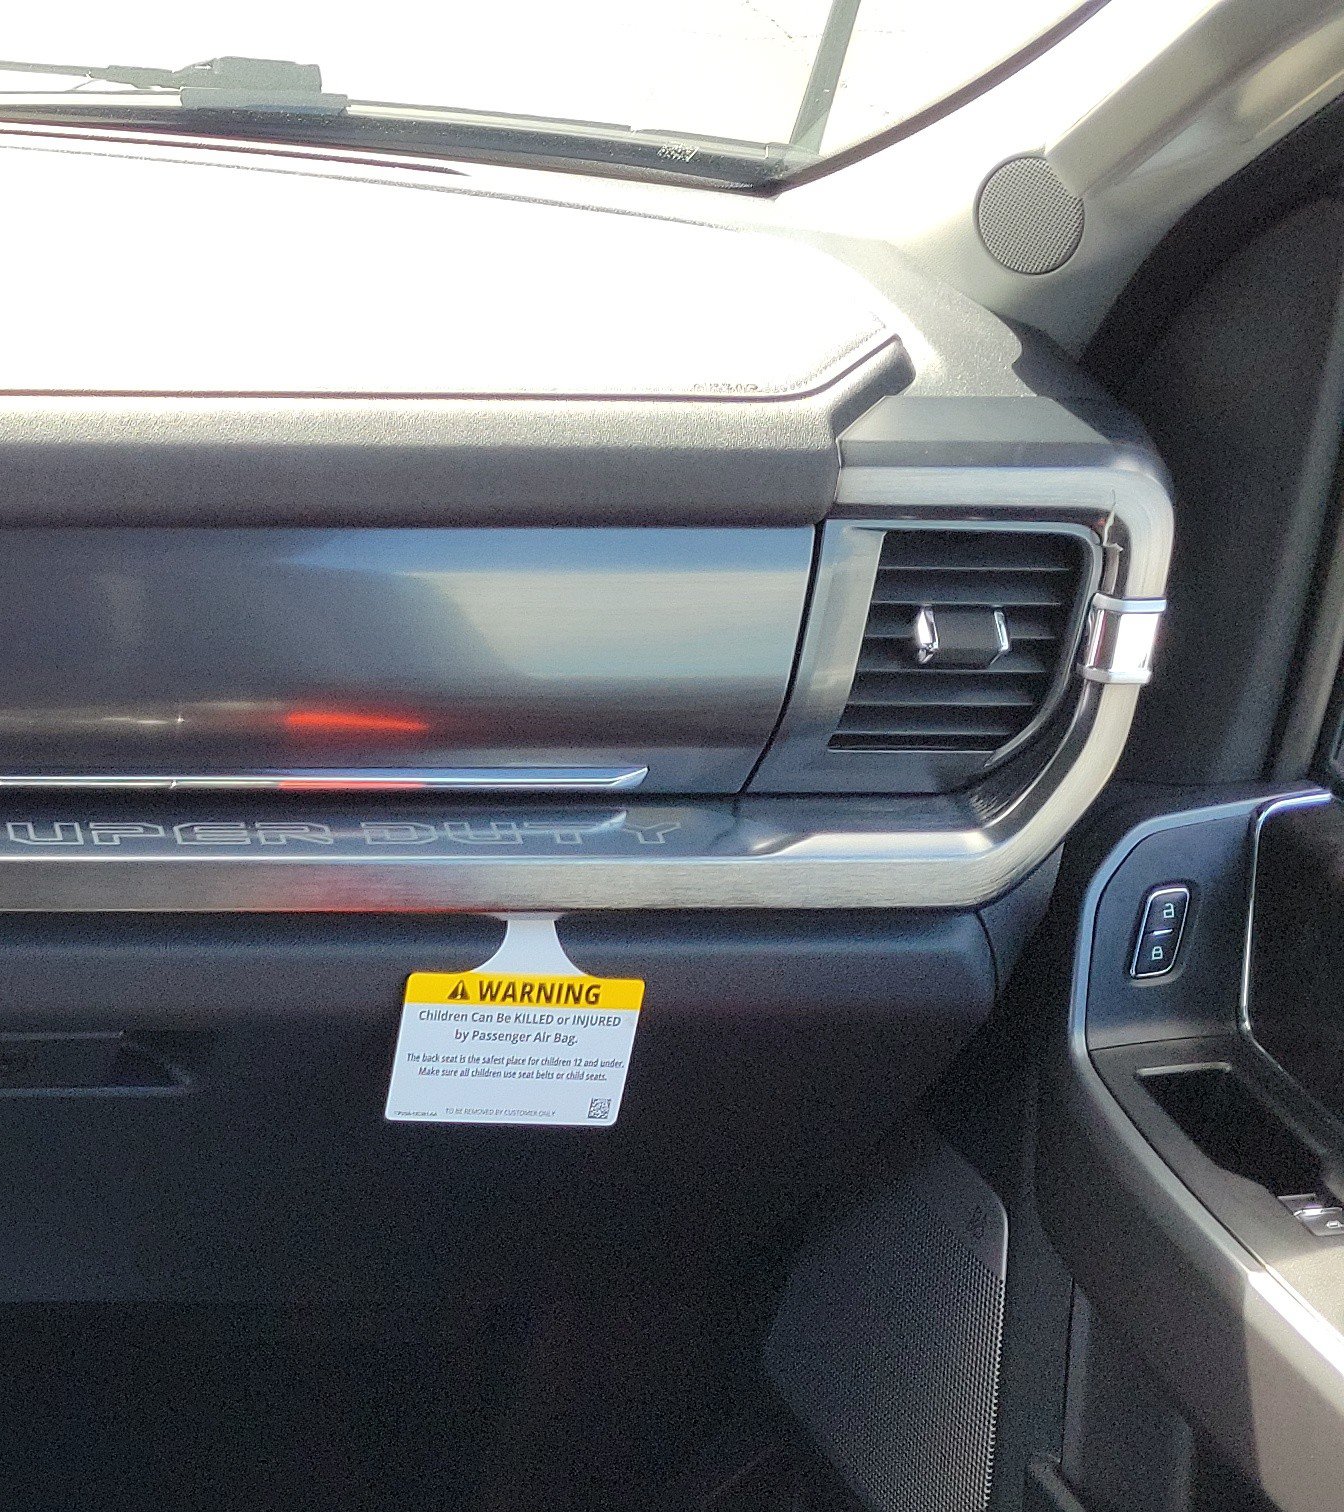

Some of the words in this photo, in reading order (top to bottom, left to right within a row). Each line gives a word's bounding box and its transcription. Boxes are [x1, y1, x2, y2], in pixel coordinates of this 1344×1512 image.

[361, 818, 682, 847] DUTY
[478, 979, 602, 1006] WARNING
[419, 1010, 468, 1023] Children
[471, 1012, 493, 1023] Can
[496, 1013, 511, 1024] Be
[514, 1013, 554, 1025] KILLED
[557, 1016, 570, 1026] or
[572, 1015, 622, 1027] INJURED
[454, 1029, 469, 1043] by
[471, 1029, 531, 1045] Passenger
[533, 1031, 551, 1043] Air
[554, 1031, 579, 1046] Bag.
[407, 1053, 420, 1062] The
[422, 1053, 440, 1063] back
[441, 1054, 458, 1063] seat
[459, 1054, 466, 1063] is
[468, 1054, 480, 1064] the
[482, 1054, 505, 1065] safest
[506, 1056, 526, 1067] place
[528, 1056, 539, 1066] for
[541, 1057, 571, 1067] children
[573, 1058, 582, 1067] 12
[584, 1058, 598, 1068] and
[600, 1058, 624, 1068] under.
[418, 1066, 440, 1076] Make
[441, 1068, 459, 1077] sure
[460, 1068, 470, 1077] all
[471, 1068, 502, 1078] children
[504, 1070, 516, 1079] use
[518, 1070, 535, 1079] seat
[536, 1070, 555, 1080] belts
[556, 1072, 564, 1080] or
[566, 1071, 584, 1080] child
[585, 1072, 608, 1081] seats.
